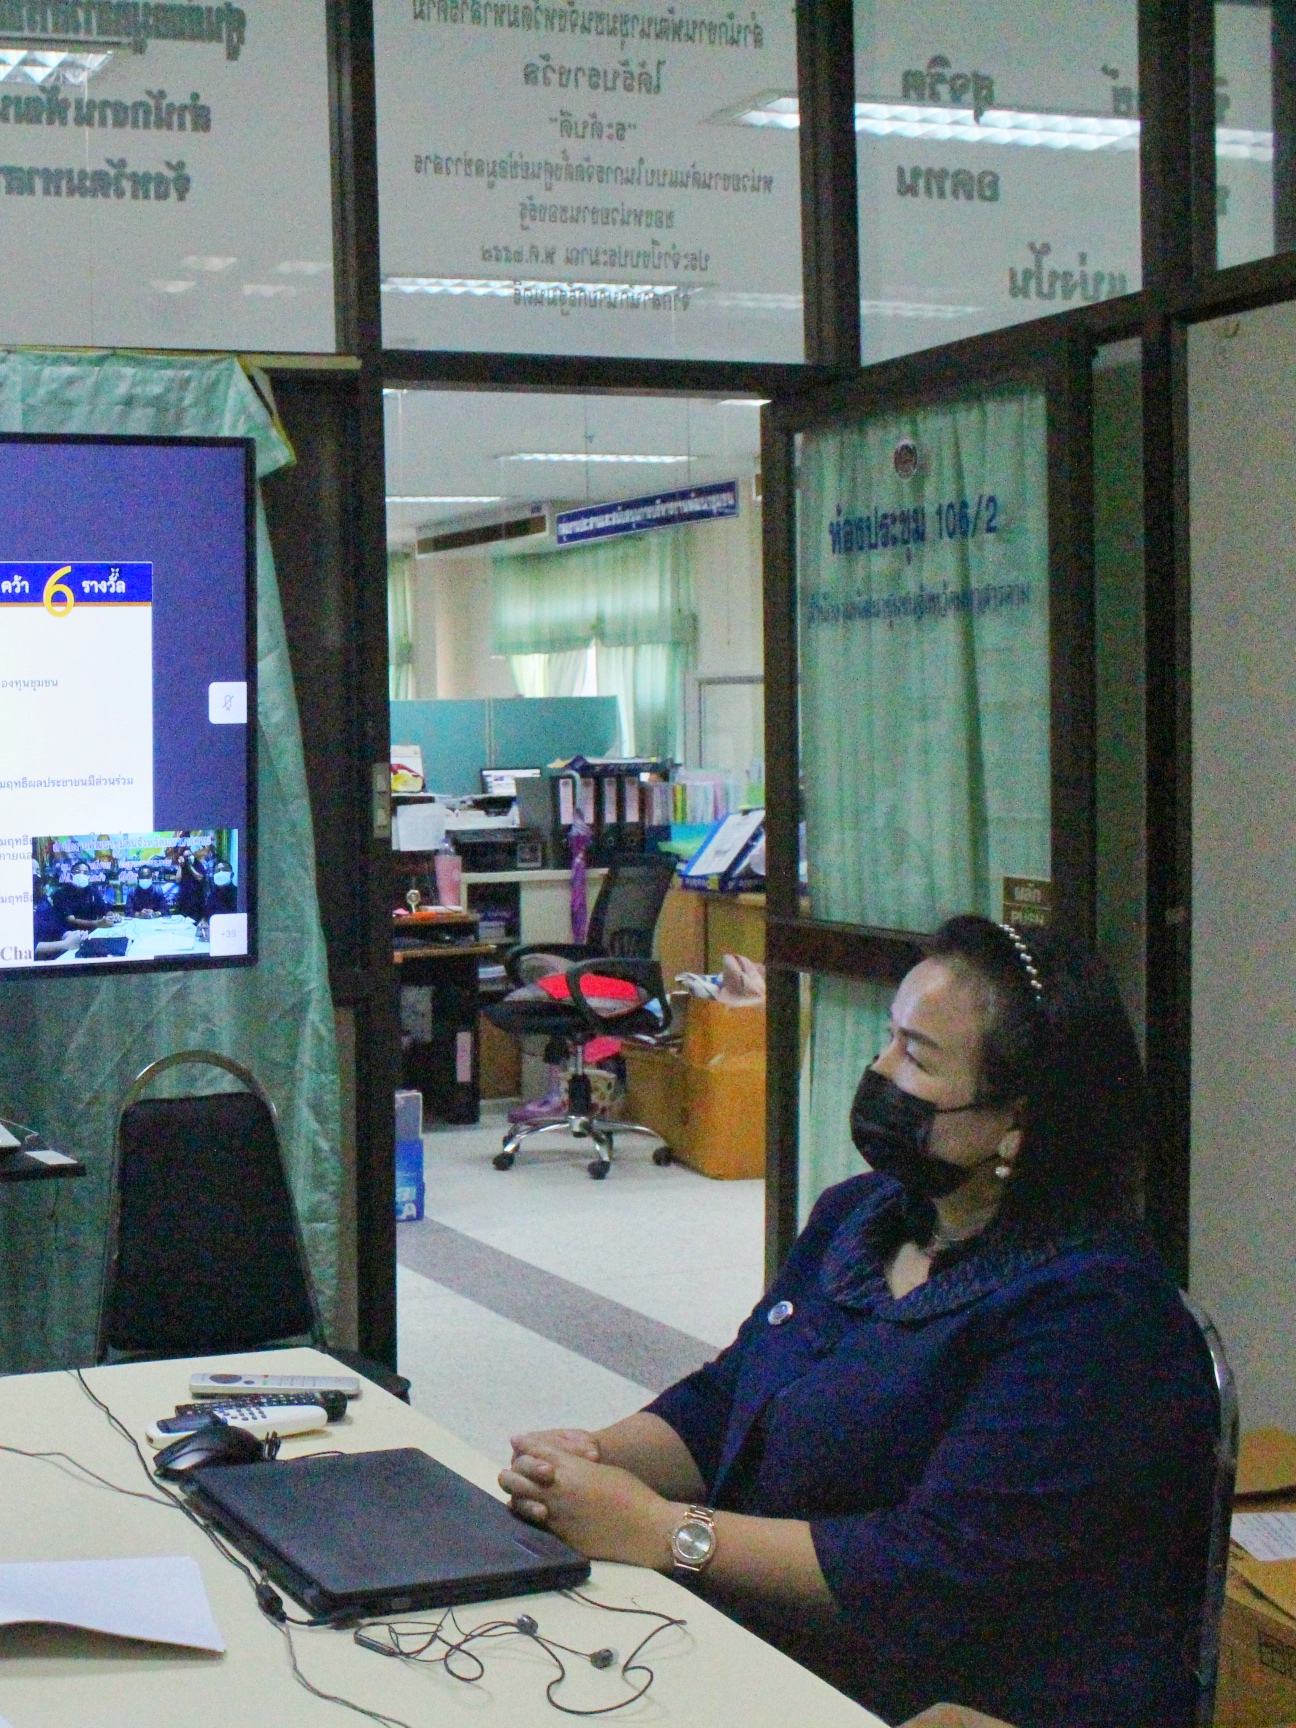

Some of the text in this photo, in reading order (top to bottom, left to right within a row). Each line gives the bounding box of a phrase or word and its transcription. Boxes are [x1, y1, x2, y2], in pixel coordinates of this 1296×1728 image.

[936, 494, 998, 540] 106/2
[2, 574, 30, 594] คว้า
[42, 565, 75, 618] 6
[82, 570, 126, 594] รางวัล
[221, 929, 236, 938] +39
[0, 946, 32, 961] Cha
